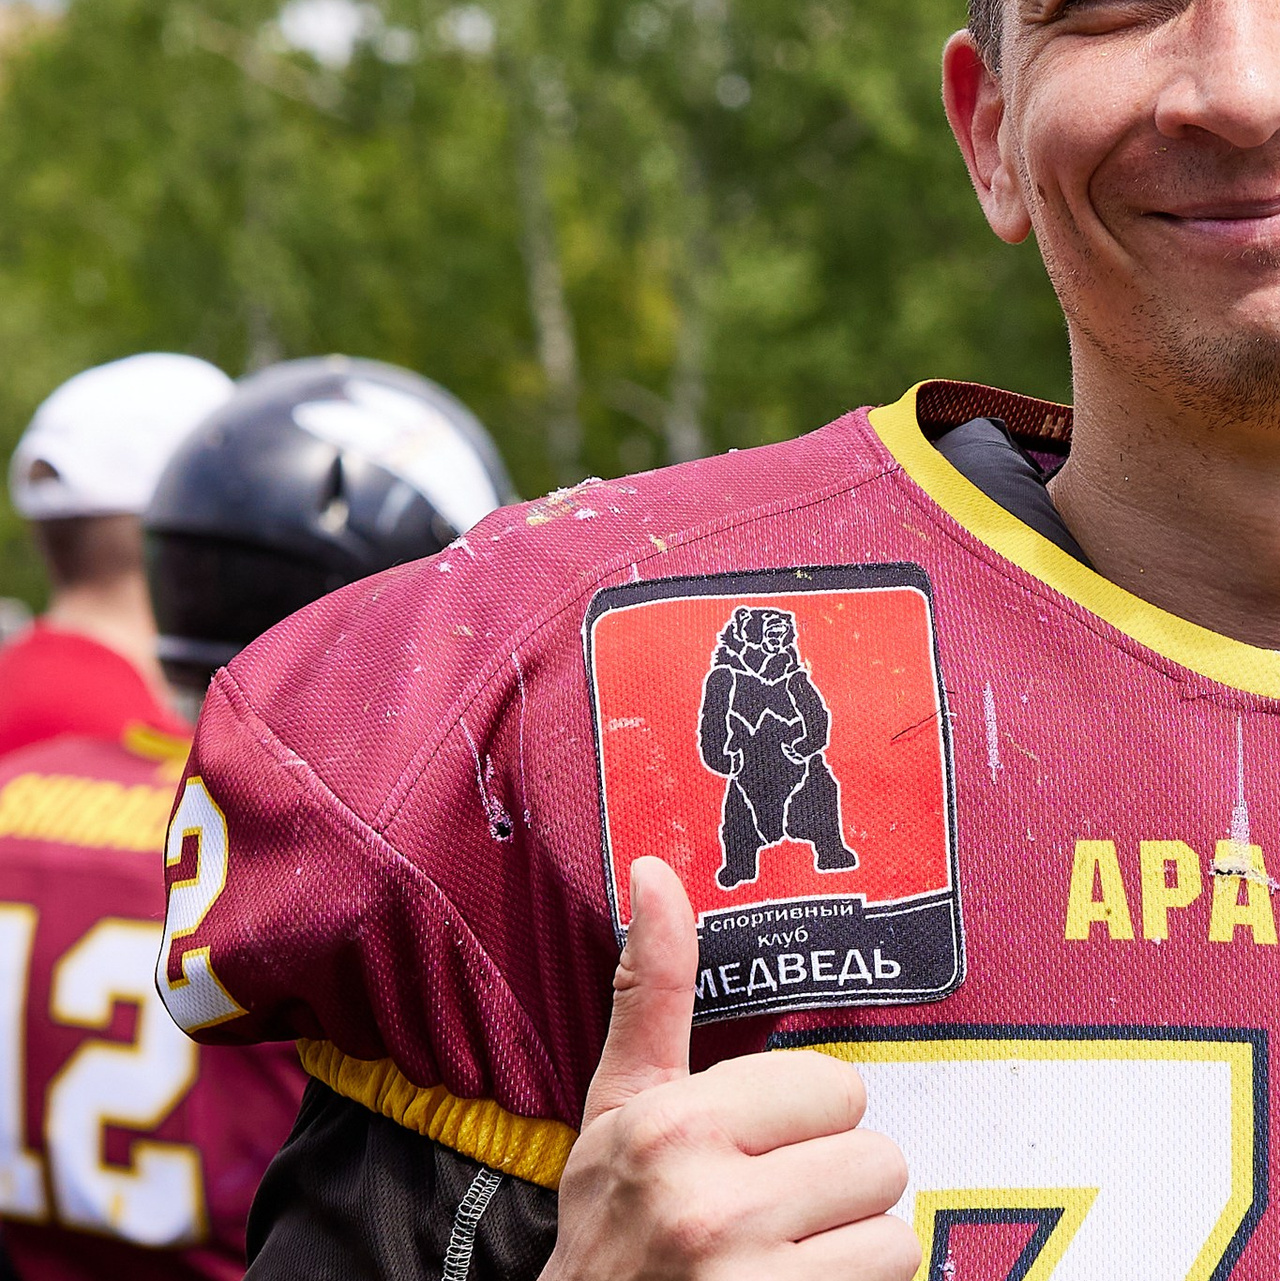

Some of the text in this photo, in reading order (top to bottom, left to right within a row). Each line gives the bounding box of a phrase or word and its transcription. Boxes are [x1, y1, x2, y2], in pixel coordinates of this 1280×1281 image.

[155, 775, 250, 1036] 2
[709, 899, 855, 933] спортивный
[757, 925, 809, 949] клуб
